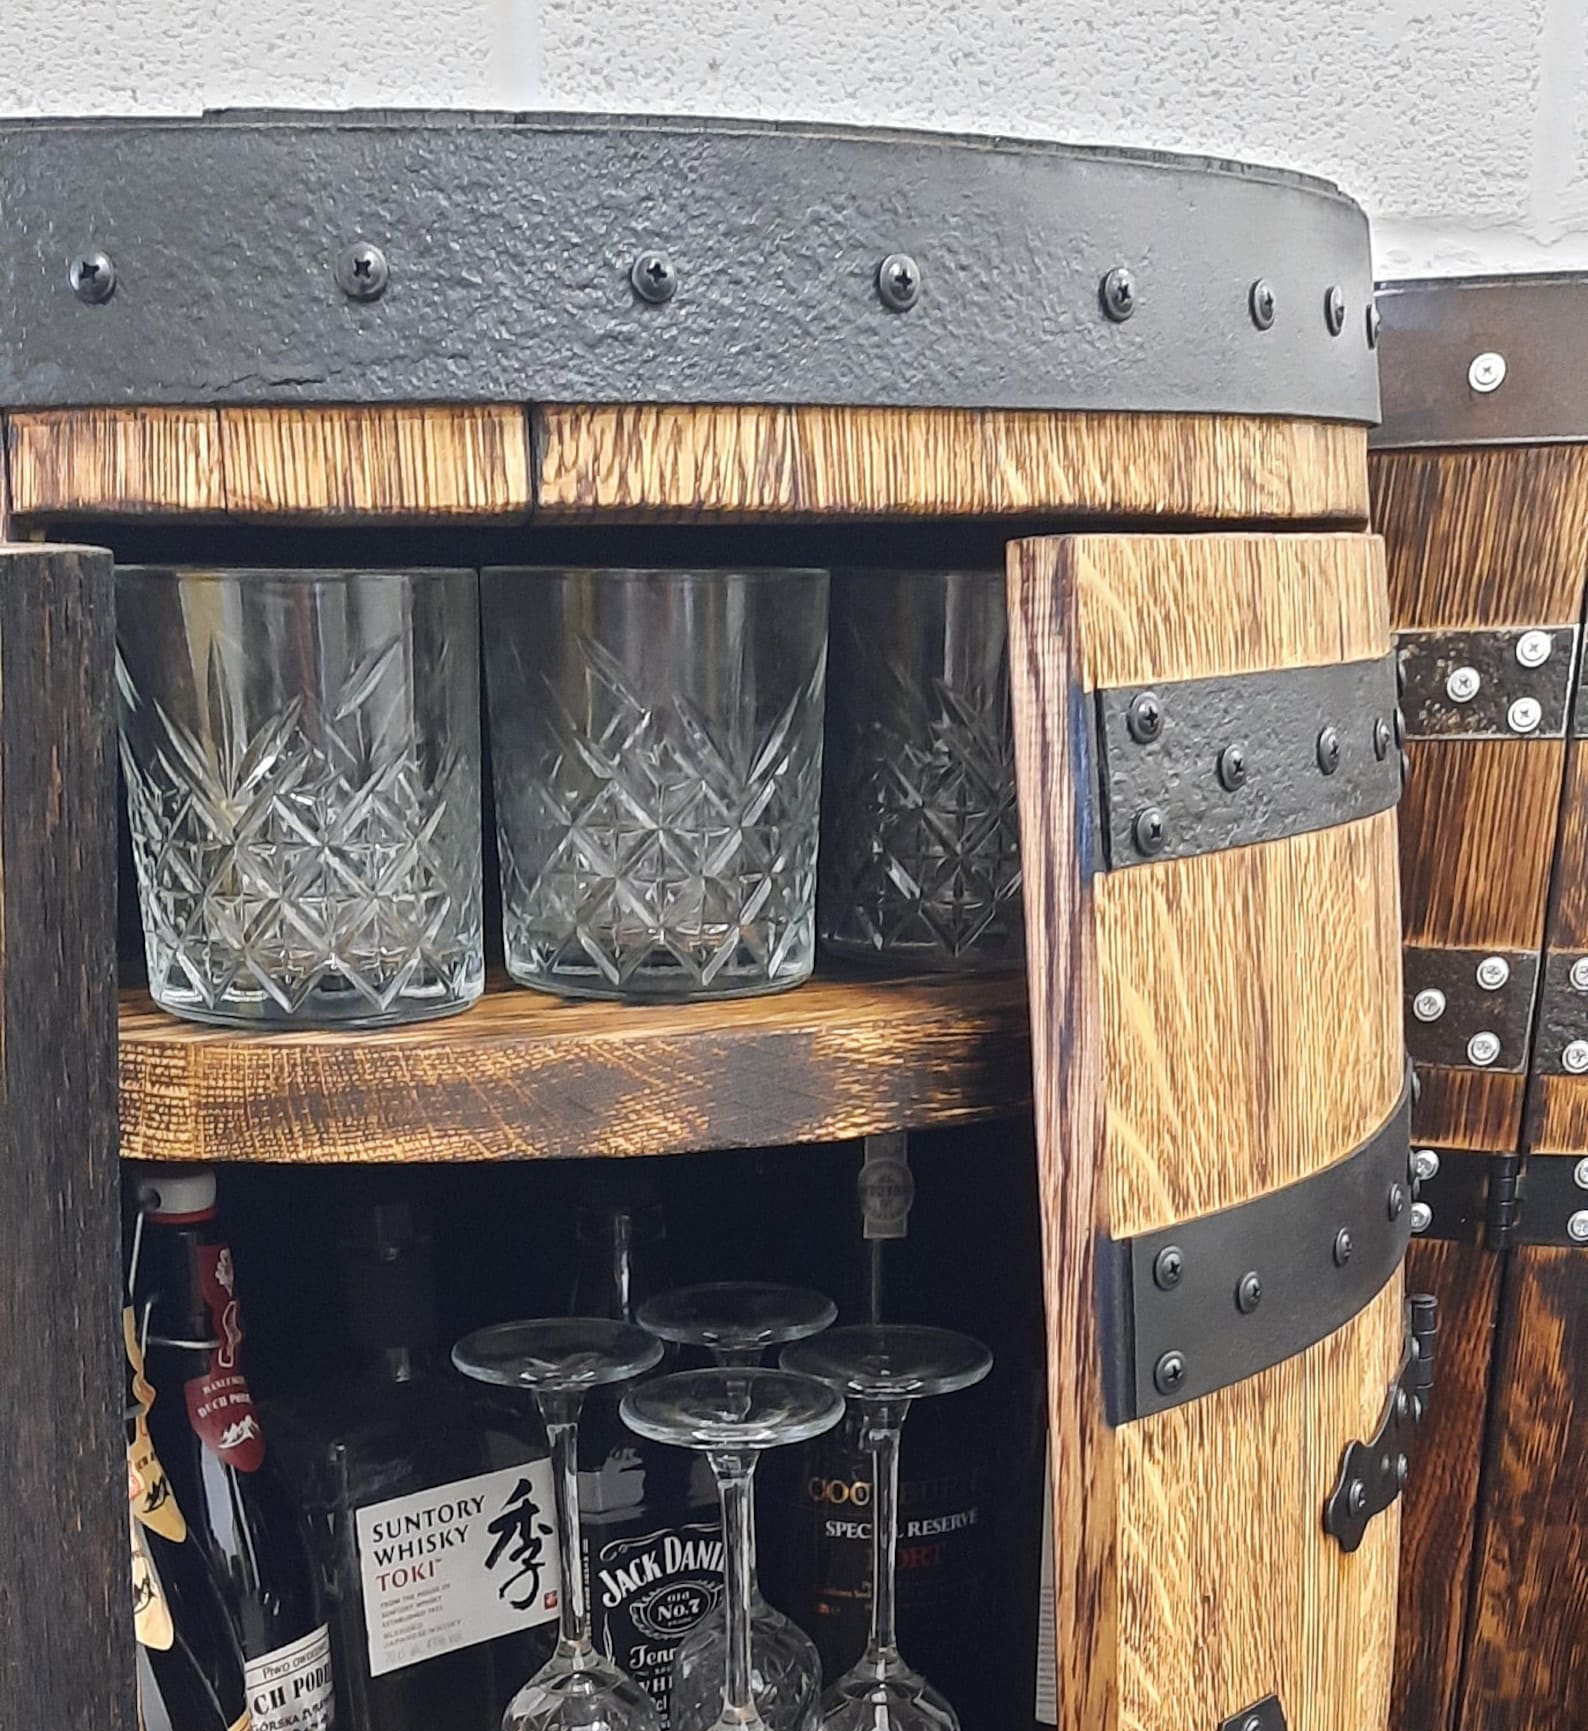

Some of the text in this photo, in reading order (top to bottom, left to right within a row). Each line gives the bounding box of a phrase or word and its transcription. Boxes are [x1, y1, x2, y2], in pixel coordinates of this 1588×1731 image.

[373, 1495, 485, 1543] SUNTORY
[907, 1508, 979, 1537] RESERVE
[374, 1524, 469, 1567] WHISKY
[598, 1551, 664, 1608] JACK
[657, 1598, 701, 1622] No.7
